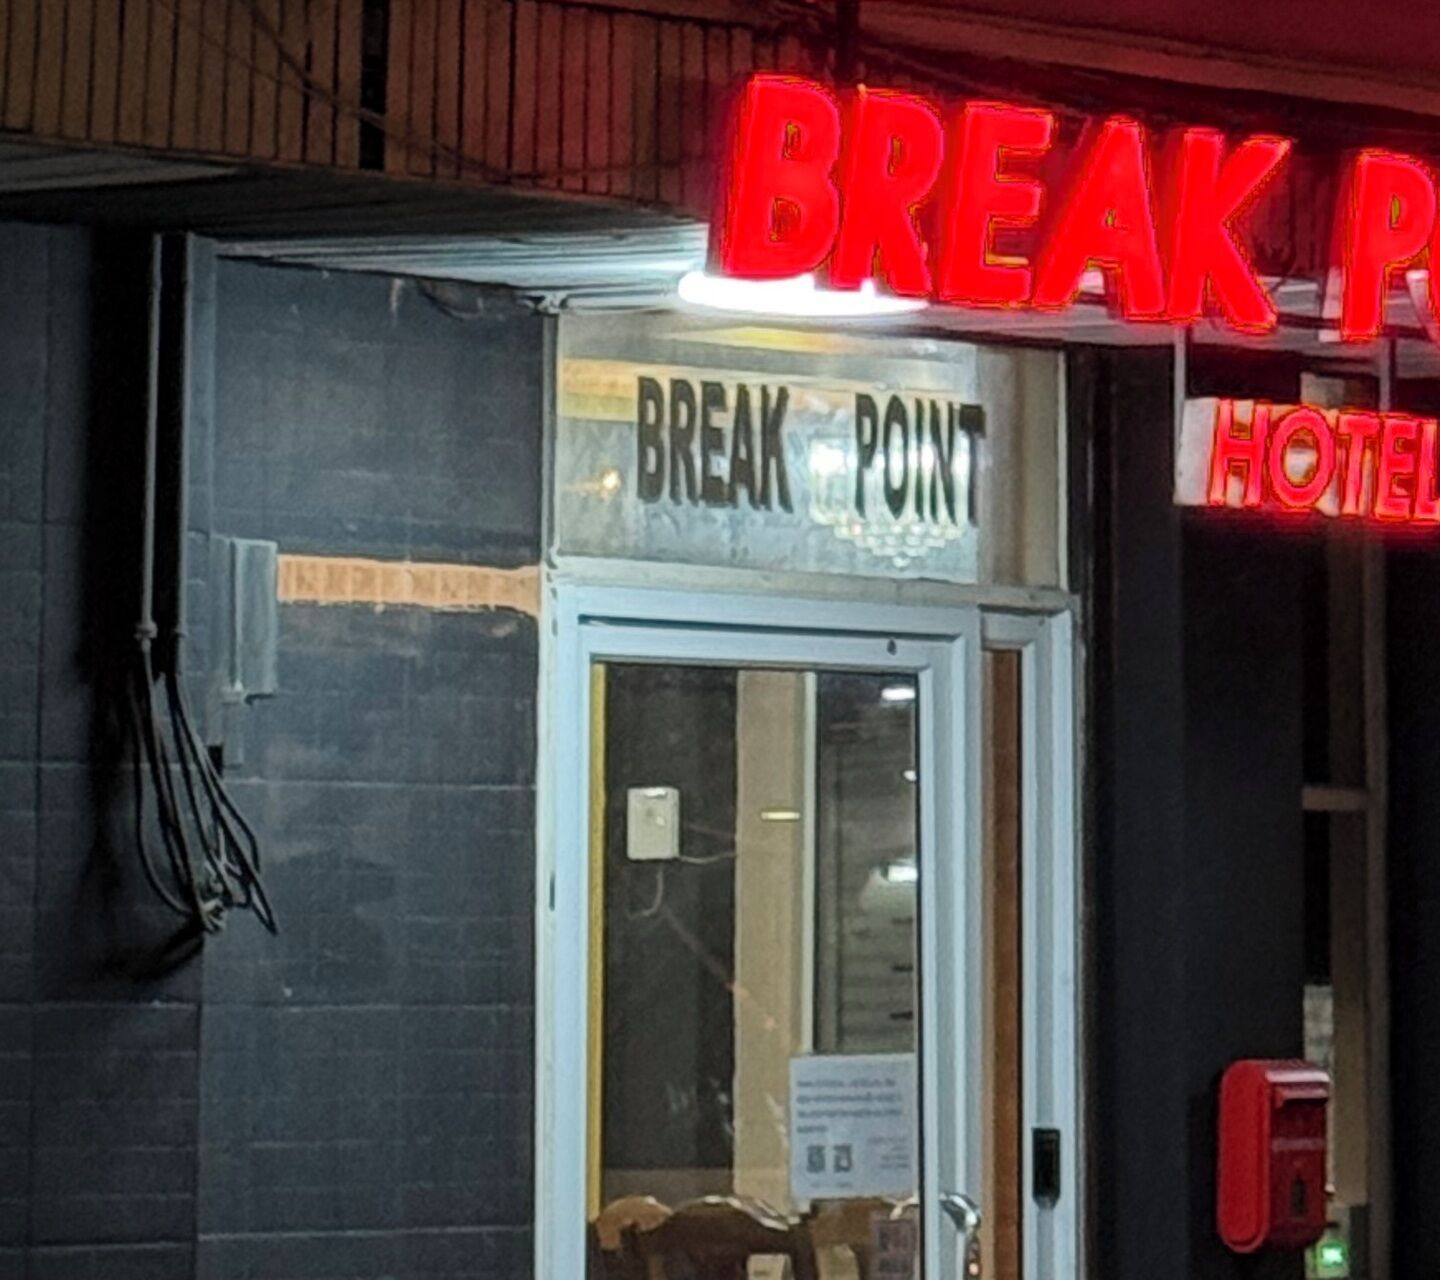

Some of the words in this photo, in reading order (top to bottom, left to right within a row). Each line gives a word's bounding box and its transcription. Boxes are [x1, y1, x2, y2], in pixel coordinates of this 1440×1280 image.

[720, 73, 1292, 335] BREAK
[637, 374, 794, 513] BREAK
[854, 391, 988, 528] POINT
